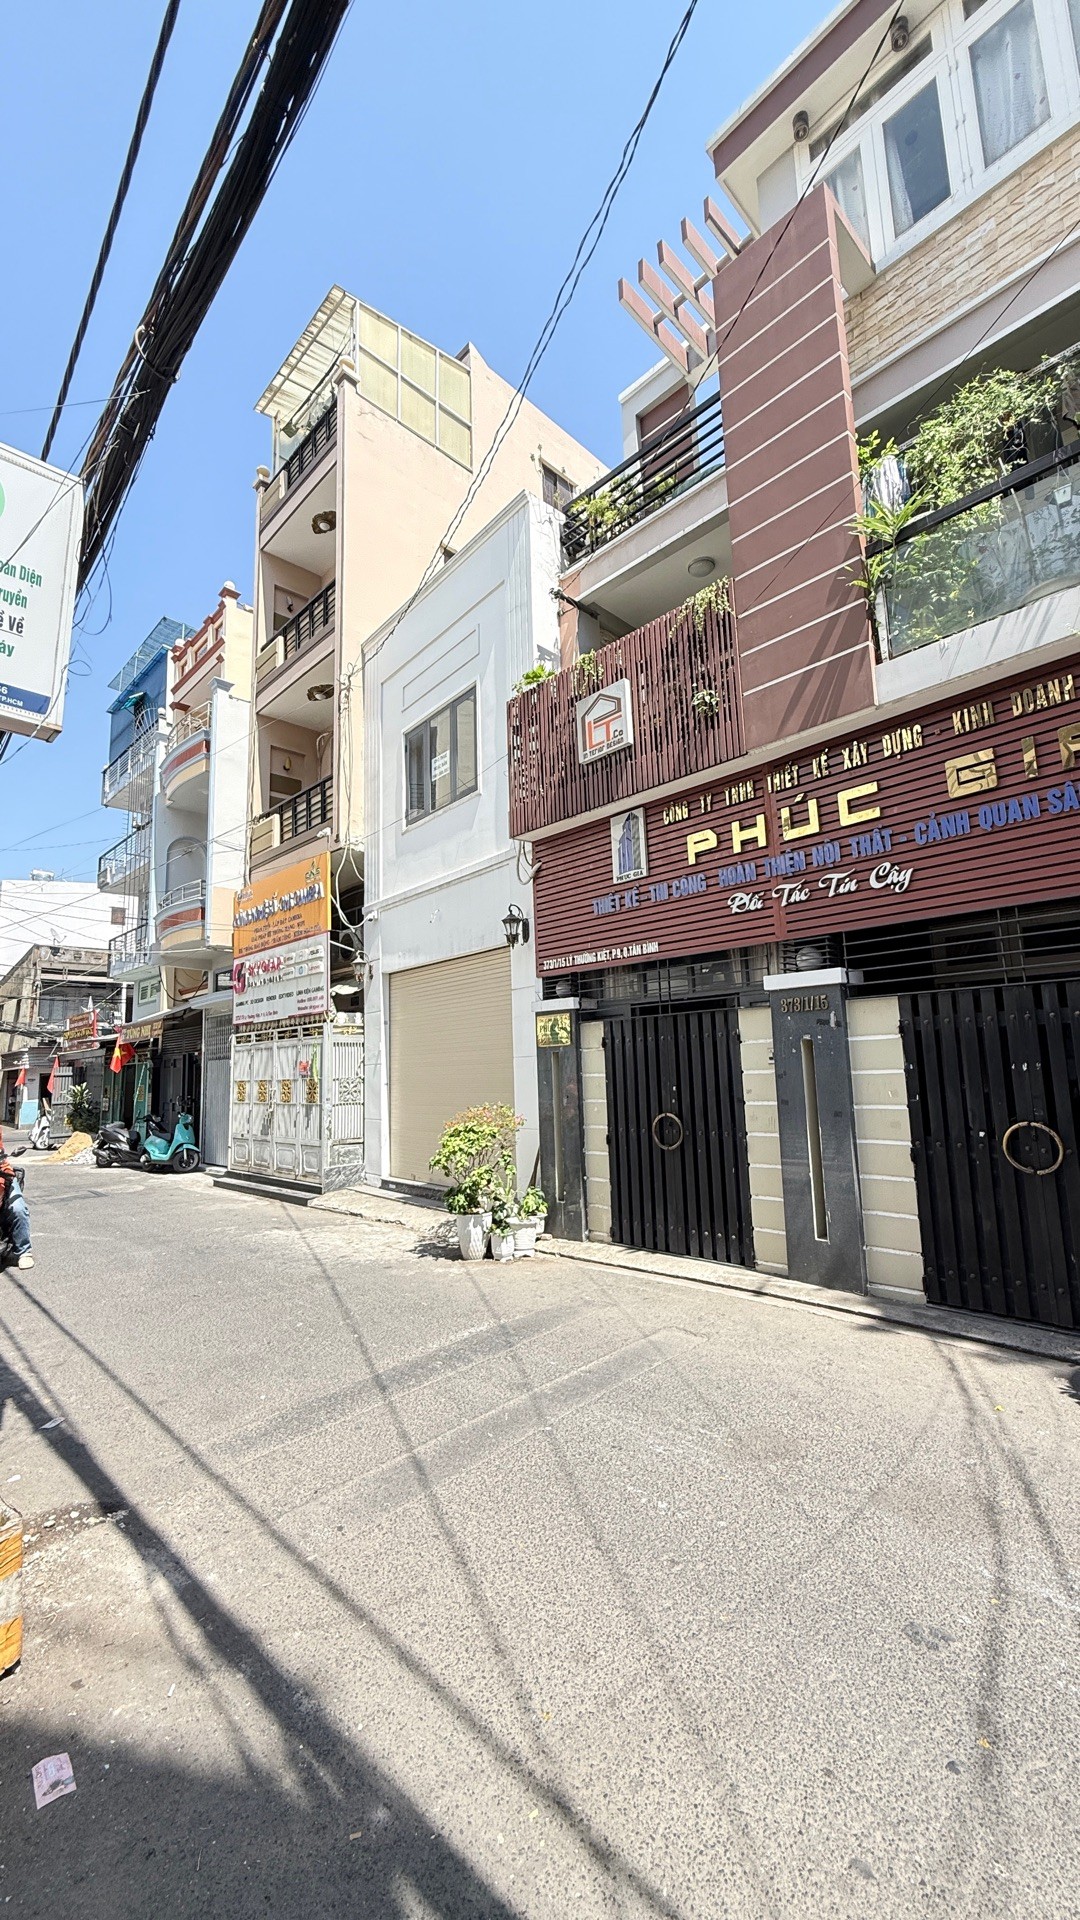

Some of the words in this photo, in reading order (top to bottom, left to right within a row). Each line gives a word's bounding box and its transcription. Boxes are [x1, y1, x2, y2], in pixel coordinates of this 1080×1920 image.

[19, 564, 42, 588] Diện
[662, 800, 689, 825] CÔNG
[699, 792, 712, 814] TY
[724, 779, 755, 806] TNHH
[766, 761, 799, 793] THIẾT
[812, 748, 830, 780] KẾ
[841, 740, 870, 770] XÂY
[881, 724, 924, 760] DỰNG
[951, 700, 996, 735] KINH
[1009, 673, 1077, 718] DOANH
[686, 781, 881, 866] PHÚC
[592, 890, 622, 916] THIẾT
[624, 883, 640, 909] KẾ
[649, 882, 669, 903] THI
[672, 873, 707, 898] CÔNG
[717, 861, 757, 888] HOÀN
[764, 848, 807, 878] THIỆN
[811, 837, 841, 868] NỘI
[849, 824, 893, 858] THẤT
[914, 811, 971, 845] CẢNH
[978, 793, 1041, 831] QUAN
[771, 878, 811, 907] Tác
[818, 867, 858, 897] Tín
[869, 862, 914, 893] Cậy
[566, 954, 573, 967] LÝ
[574, 950, 597, 965] THƯỜNG
[642, 941, 659, 955] BÌNH
[780, 994, 829, 1013] 373/1/15
